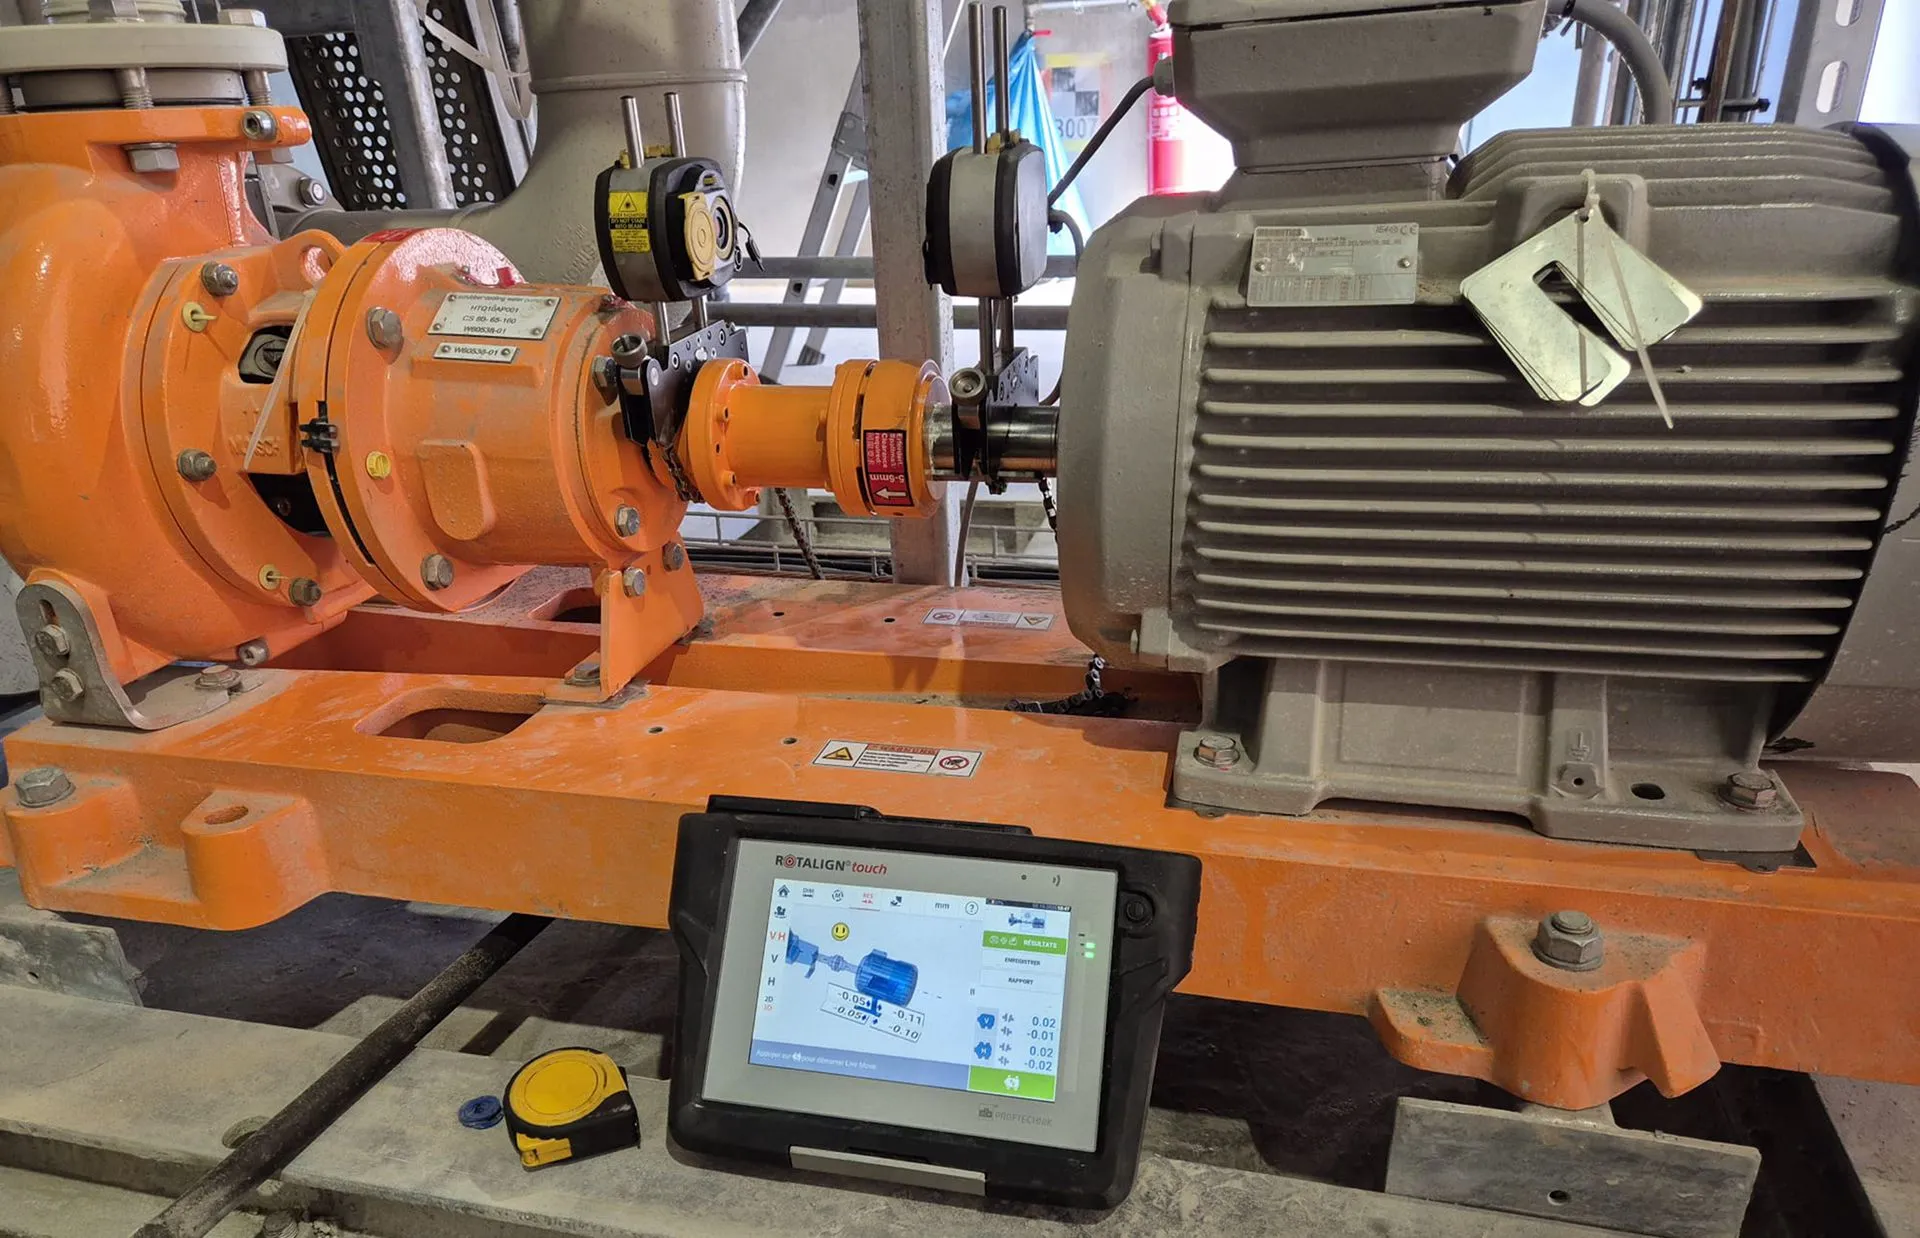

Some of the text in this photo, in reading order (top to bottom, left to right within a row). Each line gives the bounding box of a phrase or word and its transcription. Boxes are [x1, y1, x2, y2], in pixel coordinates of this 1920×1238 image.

[852, 862, 887, 875] touch
[838, 991, 866, 1006] -0.05
[893, 1009, 922, 1025] -0.11
[1032, 1016, 1056, 1028] 0.02
[888, 1024, 919, 1039] -0.10
[1026, 1029, 1054, 1041] -0.01
[1029, 1046, 1053, 1058] 0.02
[1024, 1059, 1052, 1072] -0.02
